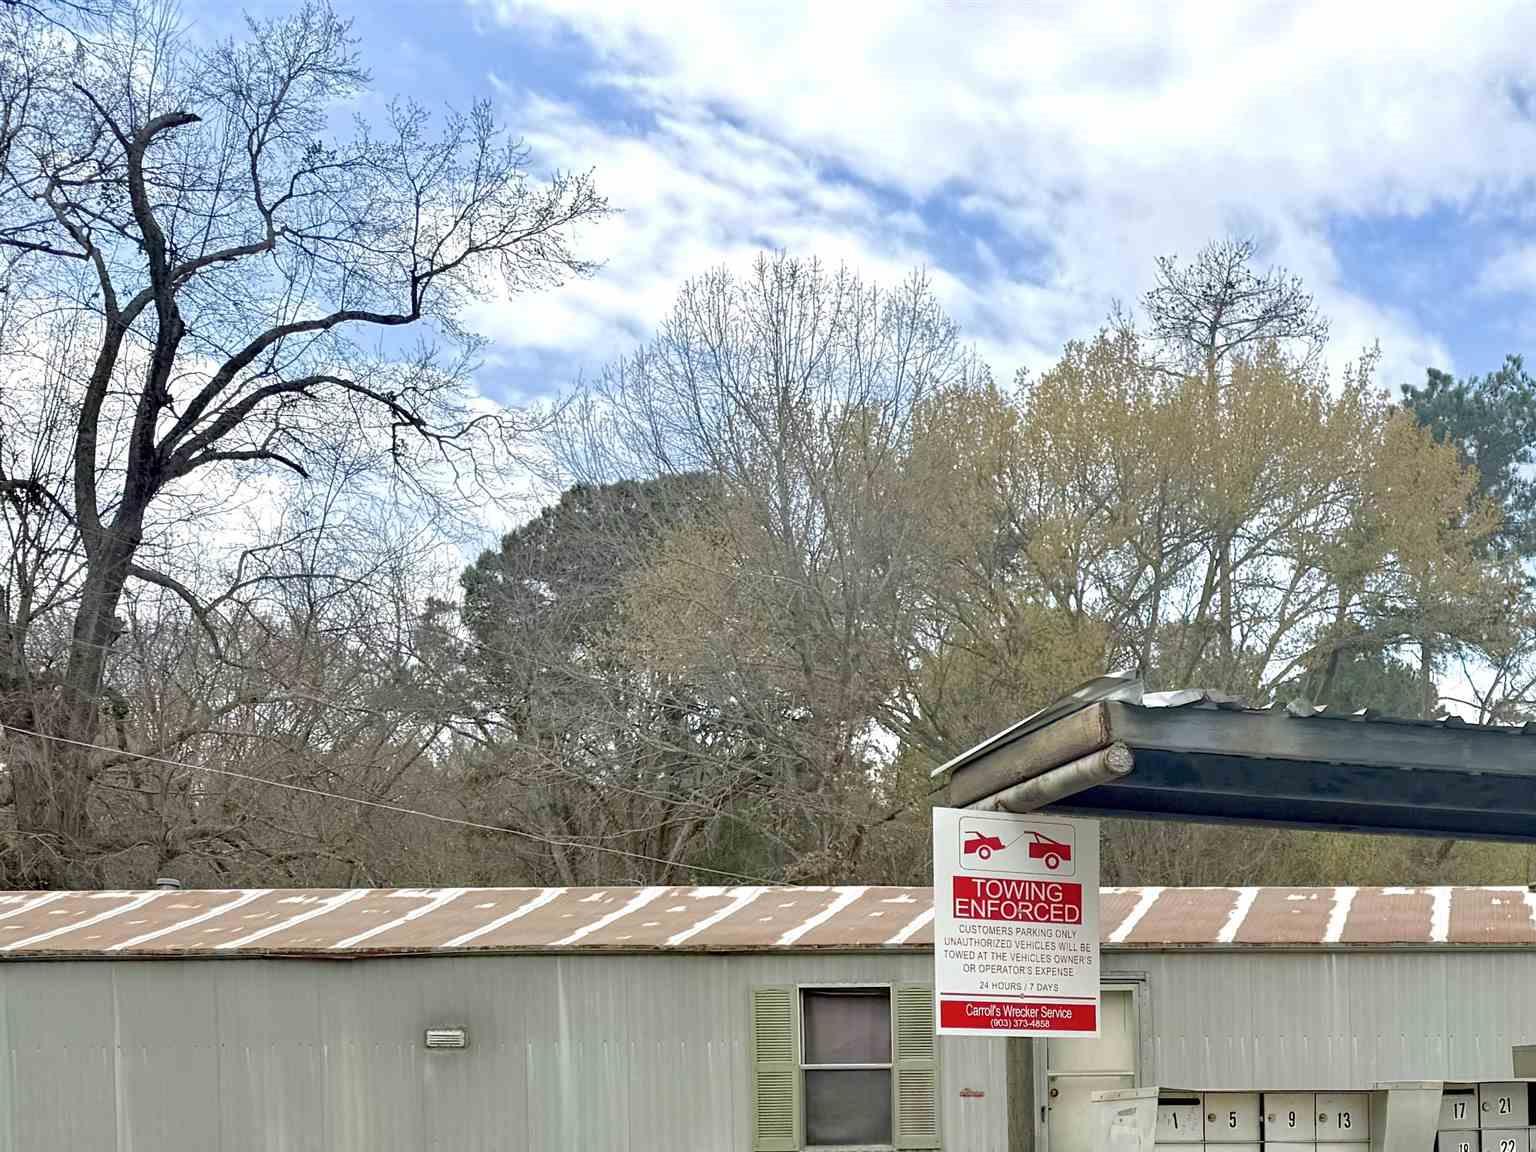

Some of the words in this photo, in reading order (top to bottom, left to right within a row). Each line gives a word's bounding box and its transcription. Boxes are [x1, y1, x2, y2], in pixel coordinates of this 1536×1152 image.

[971, 878, 1063, 902] TOWING
[955, 898, 1080, 922] ENFORCED
[959, 924, 1014, 936] CUSTOMERS
[1015, 927, 1053, 938] PARKING
[1055, 929, 1077, 939] ONLY
[944, 936, 1013, 949] UNAUTHORIZED
[1014, 940, 1057, 951] VEHICLES
[1058, 942, 1078, 952] WILL
[1080, 943, 1092, 953] BE
[944, 949, 976, 960] TOWED
[977, 951, 989, 961] AT
[990, 952, 1008, 962] THE
[1009, 952, 1052, 964] VEHICLES
[1053, 954, 1093, 965] OWNER'S
[962, 963, 976, 973] OR
[978, 964, 1033, 976] OPERATOR'S
[1035, 966, 1075, 977] EXPENSE
[979, 981, 989, 990] 24
[991, 981, 1022, 991] HOURS
[1029, 982, 1035, 991] 7
[1036, 983, 1059, 992] DAYS
[965, 1003, 1001, 1017] Carroll's
[1002, 1004, 1040, 1018] Wrecker
[1040, 1005, 1073, 1019] Service
[990, 1018, 1012, 1028] (903)
[1453, 1102, 1466, 1119] 17
[1498, 1096, 1511, 1114] 21
[1229, 1111, 1237, 1128] 5
[1288, 1111, 1296, 1128] 9
[1337, 1111, 1351, 1129] 13
